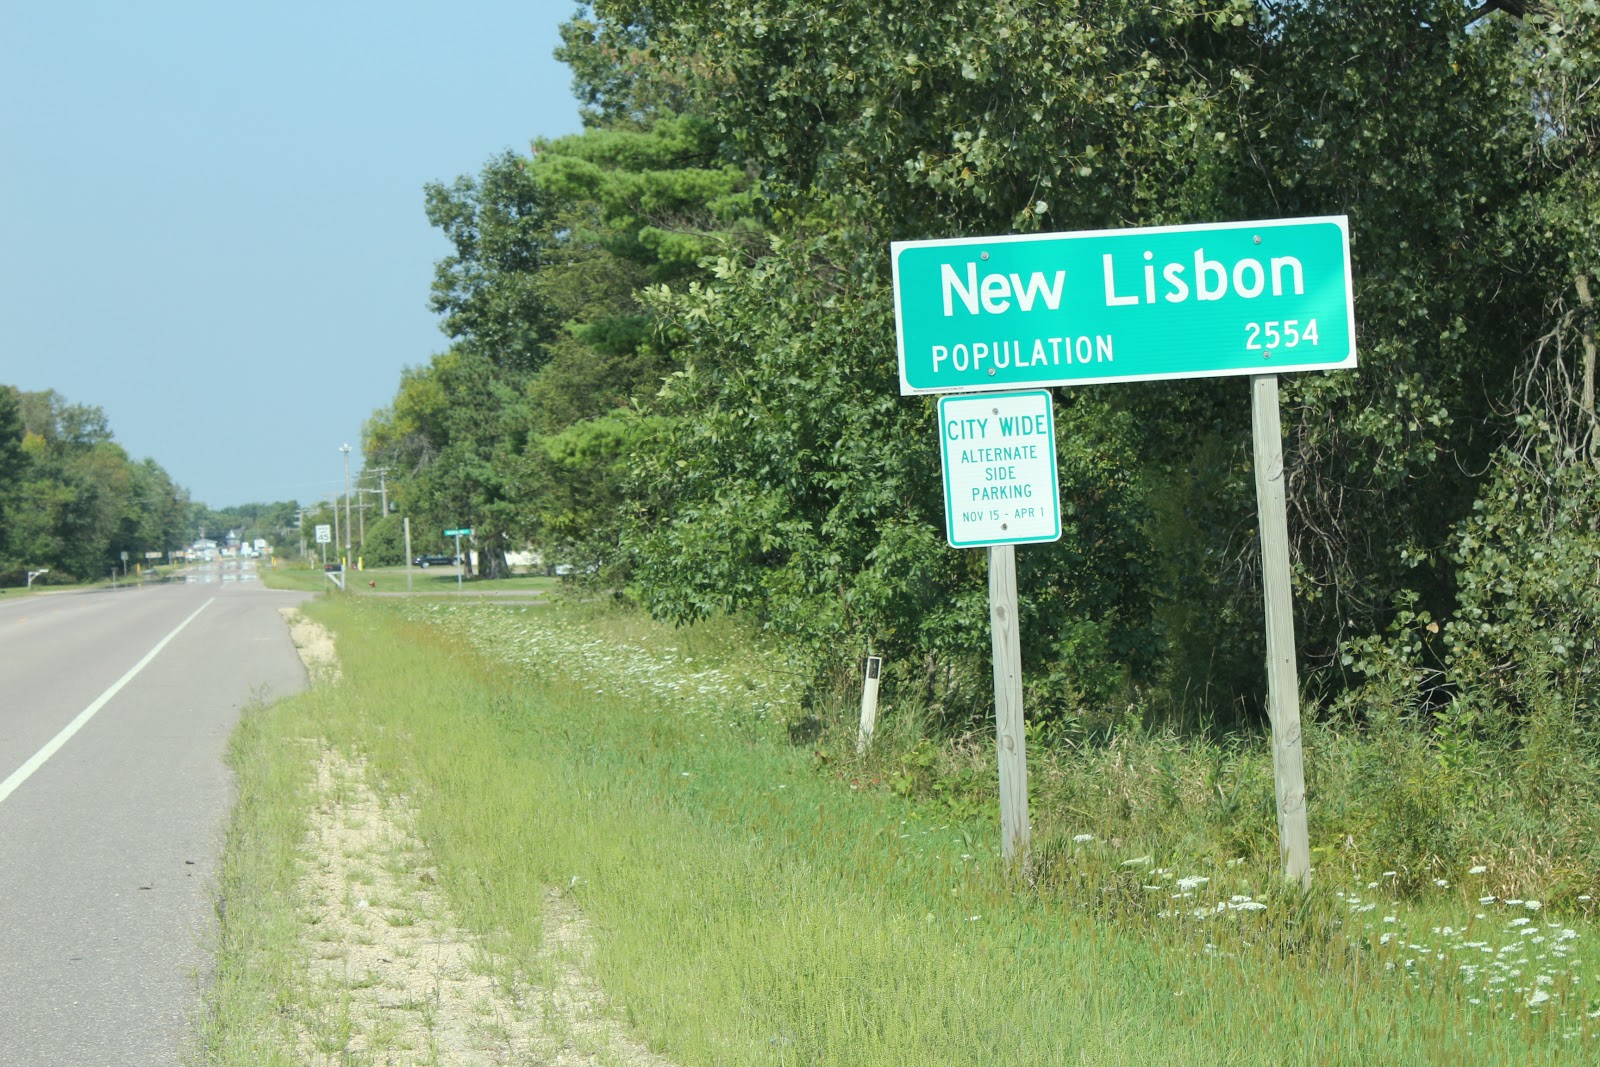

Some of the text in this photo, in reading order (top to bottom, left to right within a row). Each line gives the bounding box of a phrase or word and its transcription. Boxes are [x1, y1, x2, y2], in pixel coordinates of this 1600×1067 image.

[940, 248, 1305, 316] New Lisbon
[931, 319, 1319, 372] POPULATION 2554
[947, 415, 1047, 441] CITY WIDE
[961, 445, 1037, 464] ALTERNATE
[985, 466, 1016, 481] SIDE
[972, 484, 1032, 501] PARKING
[962, 511, 983, 523] NOV
[989, 510, 1000, 521] 15
[1014, 507, 1035, 519] APR
[1040, 506, 1044, 517] 1
[318, 533, 329, 541] 45
